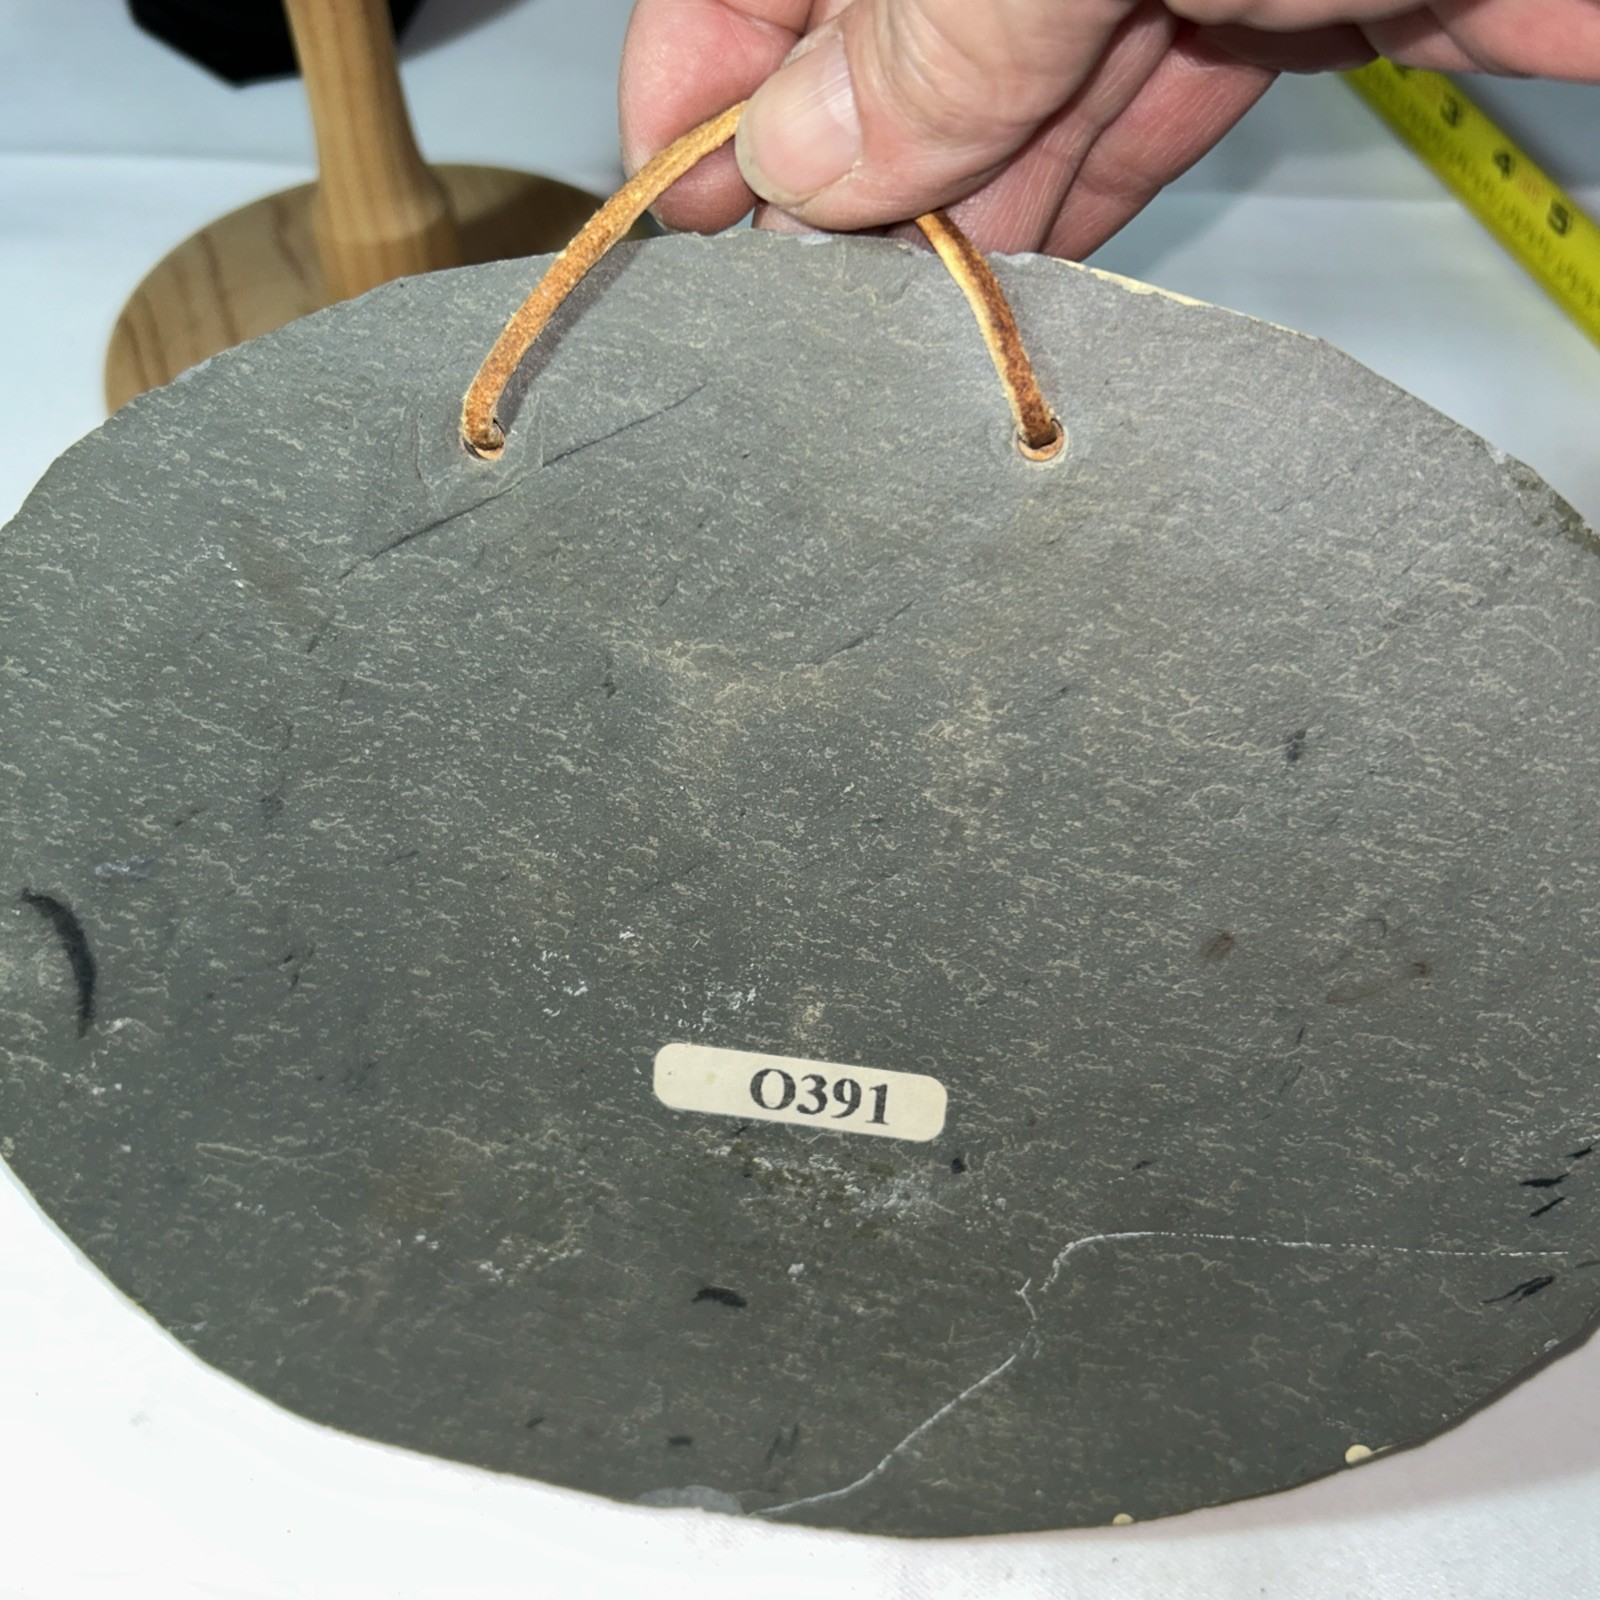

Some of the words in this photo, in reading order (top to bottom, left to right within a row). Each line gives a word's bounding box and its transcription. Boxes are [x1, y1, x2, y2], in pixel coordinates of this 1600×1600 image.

[1440, 94, 1462, 128] 3
[1493, 150, 1514, 180] 4
[1548, 201, 1573, 236] 5
